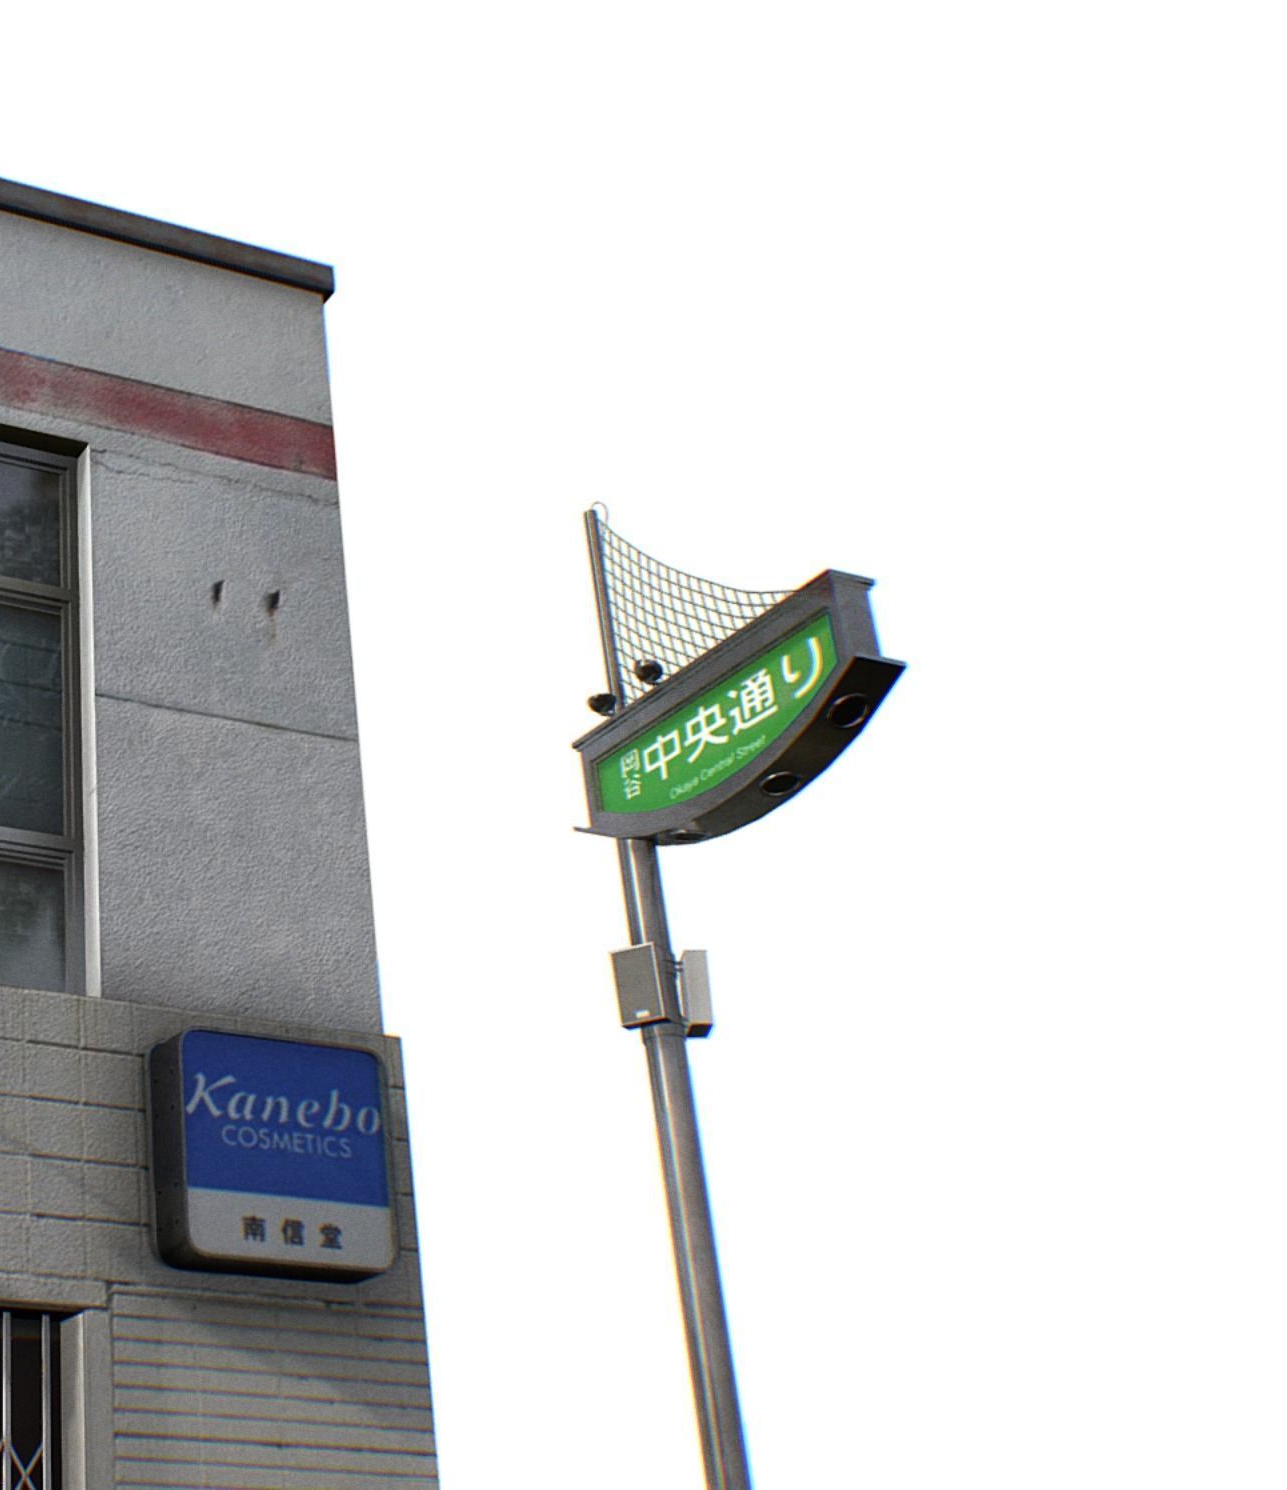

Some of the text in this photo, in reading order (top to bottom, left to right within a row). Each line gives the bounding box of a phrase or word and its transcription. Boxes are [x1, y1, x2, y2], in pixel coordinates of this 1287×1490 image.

[643, 638, 823, 780] 中央通り
[185, 1072, 380, 1135] Kanebo
[222, 1124, 352, 1158] COSMETICS
[242, 1215, 342, 1249] 南信堂
